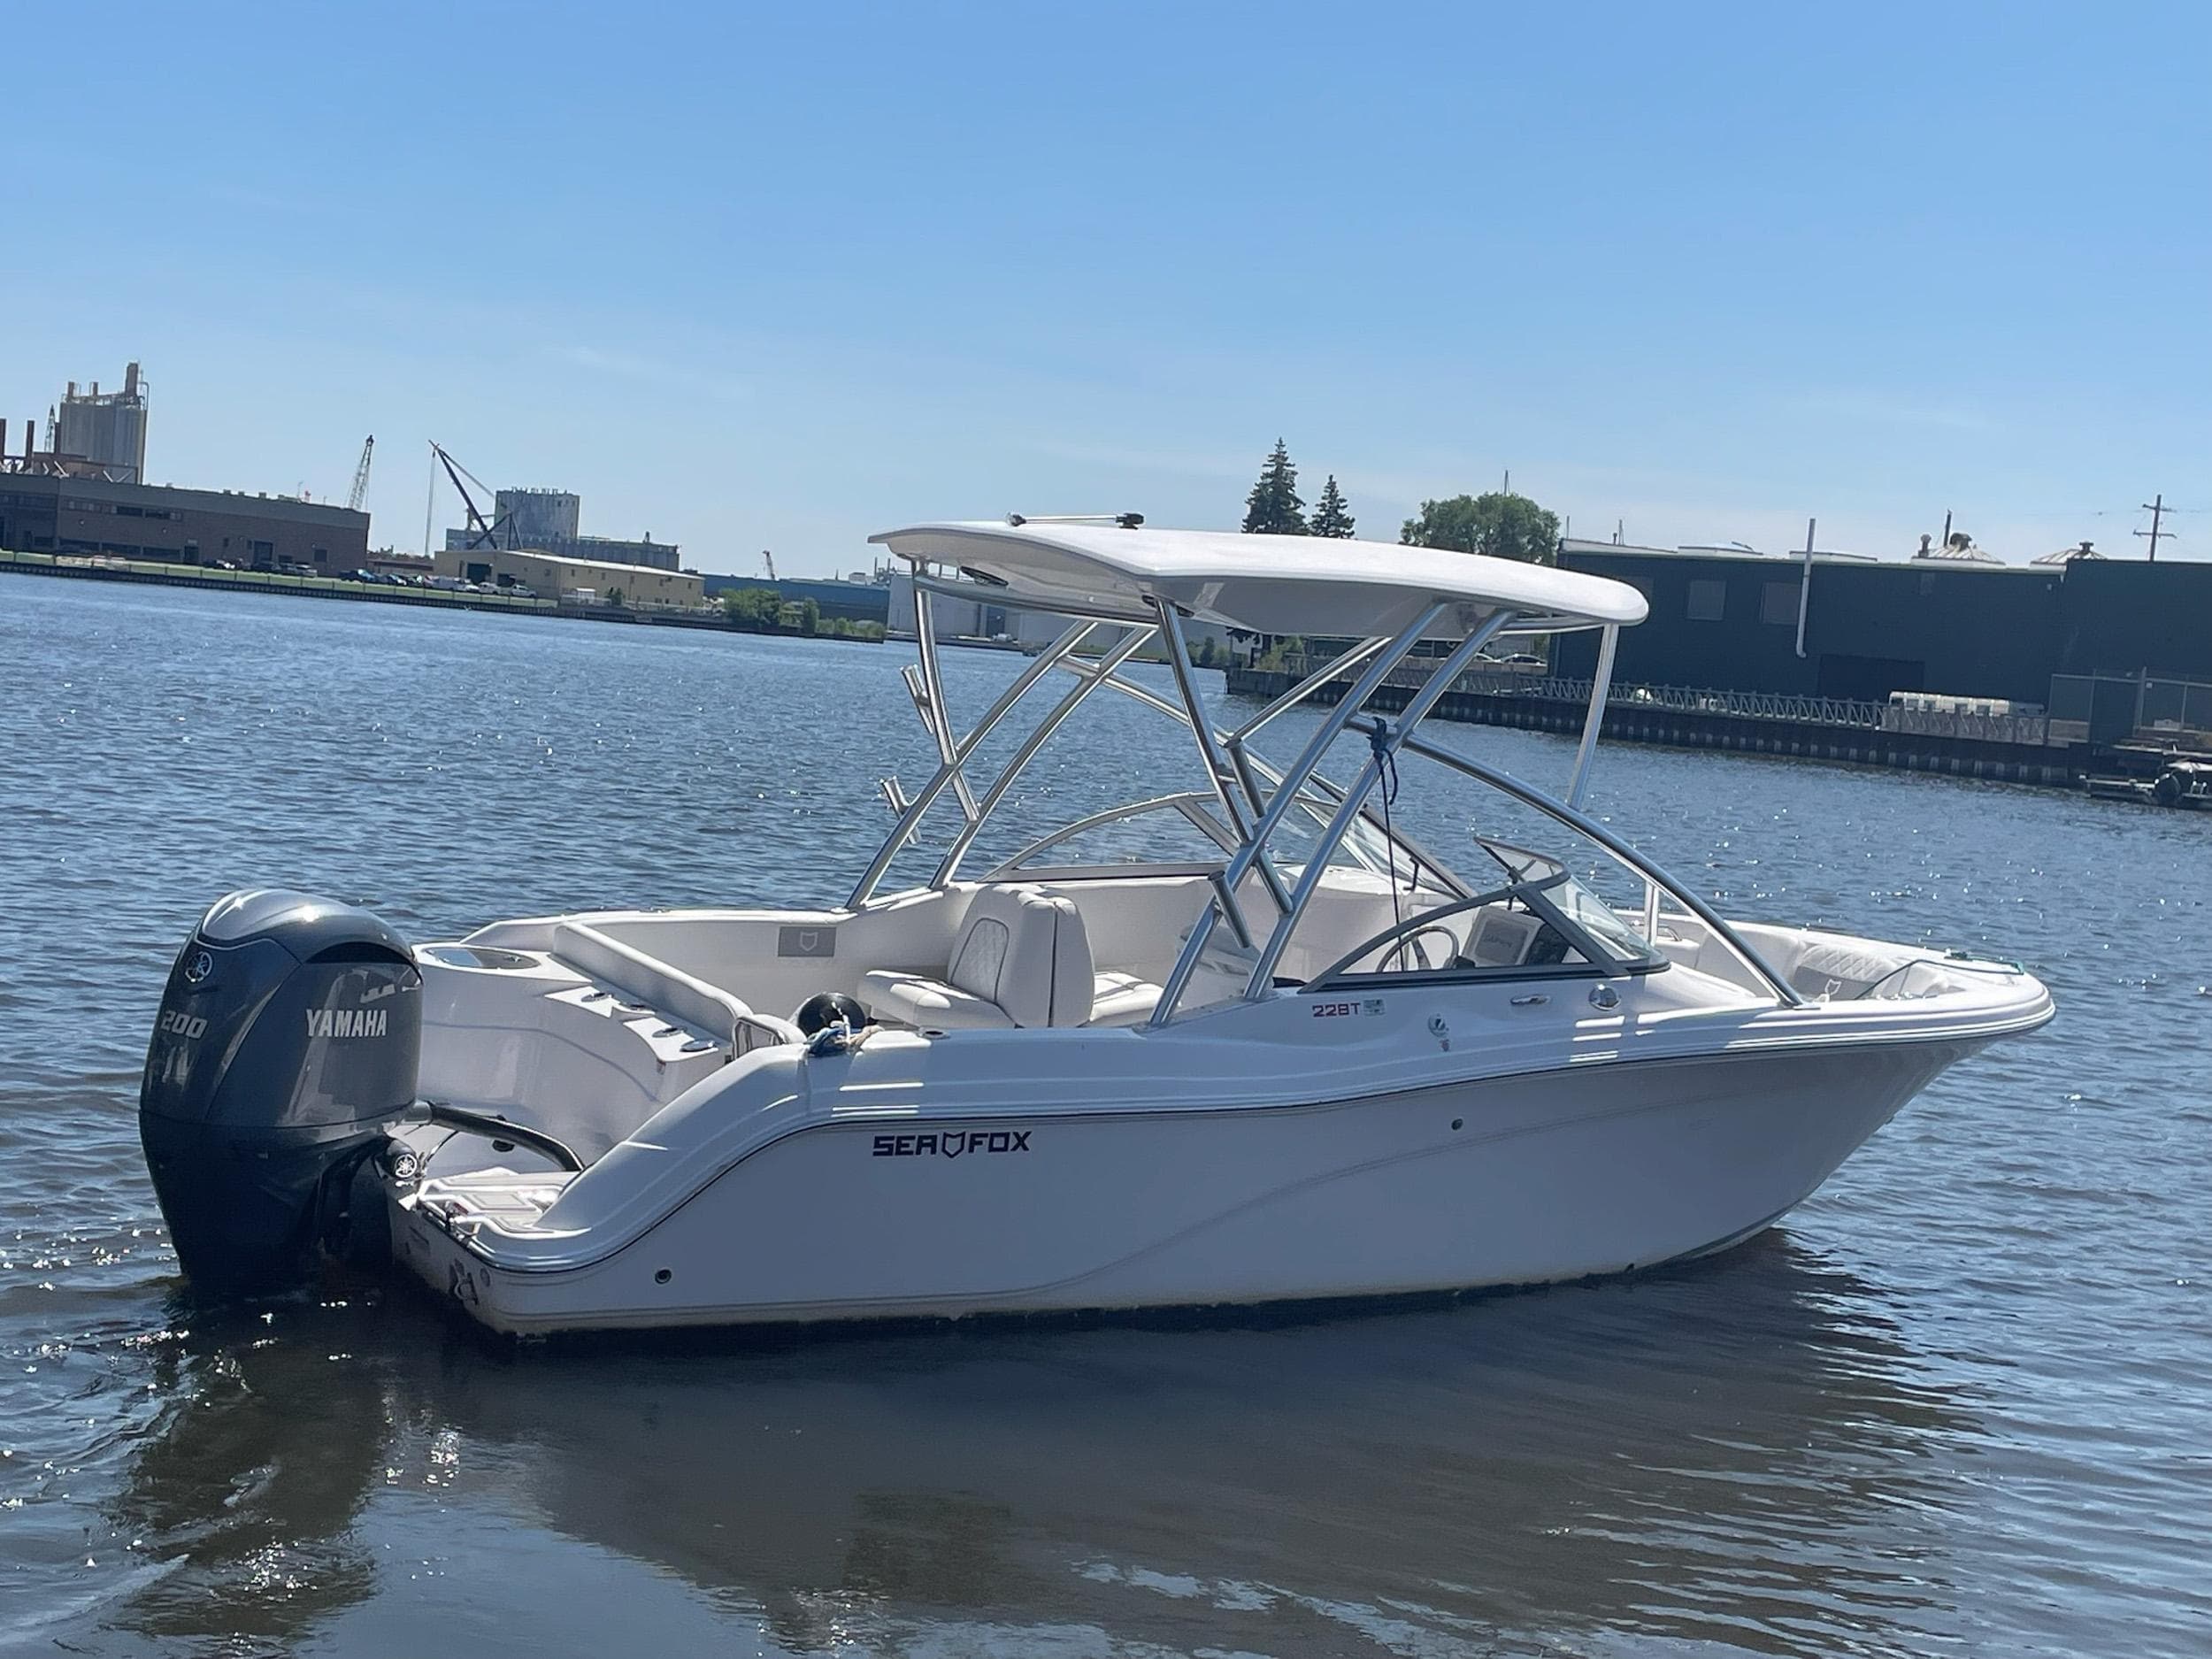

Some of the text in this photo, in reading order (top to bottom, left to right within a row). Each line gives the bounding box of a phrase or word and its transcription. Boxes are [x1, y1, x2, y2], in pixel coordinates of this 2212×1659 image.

[160, 1010, 208, 1039] 200
[306, 1009, 388, 1037] YAMAHA
[872, 1131, 1033, 1156] SEA FOX
